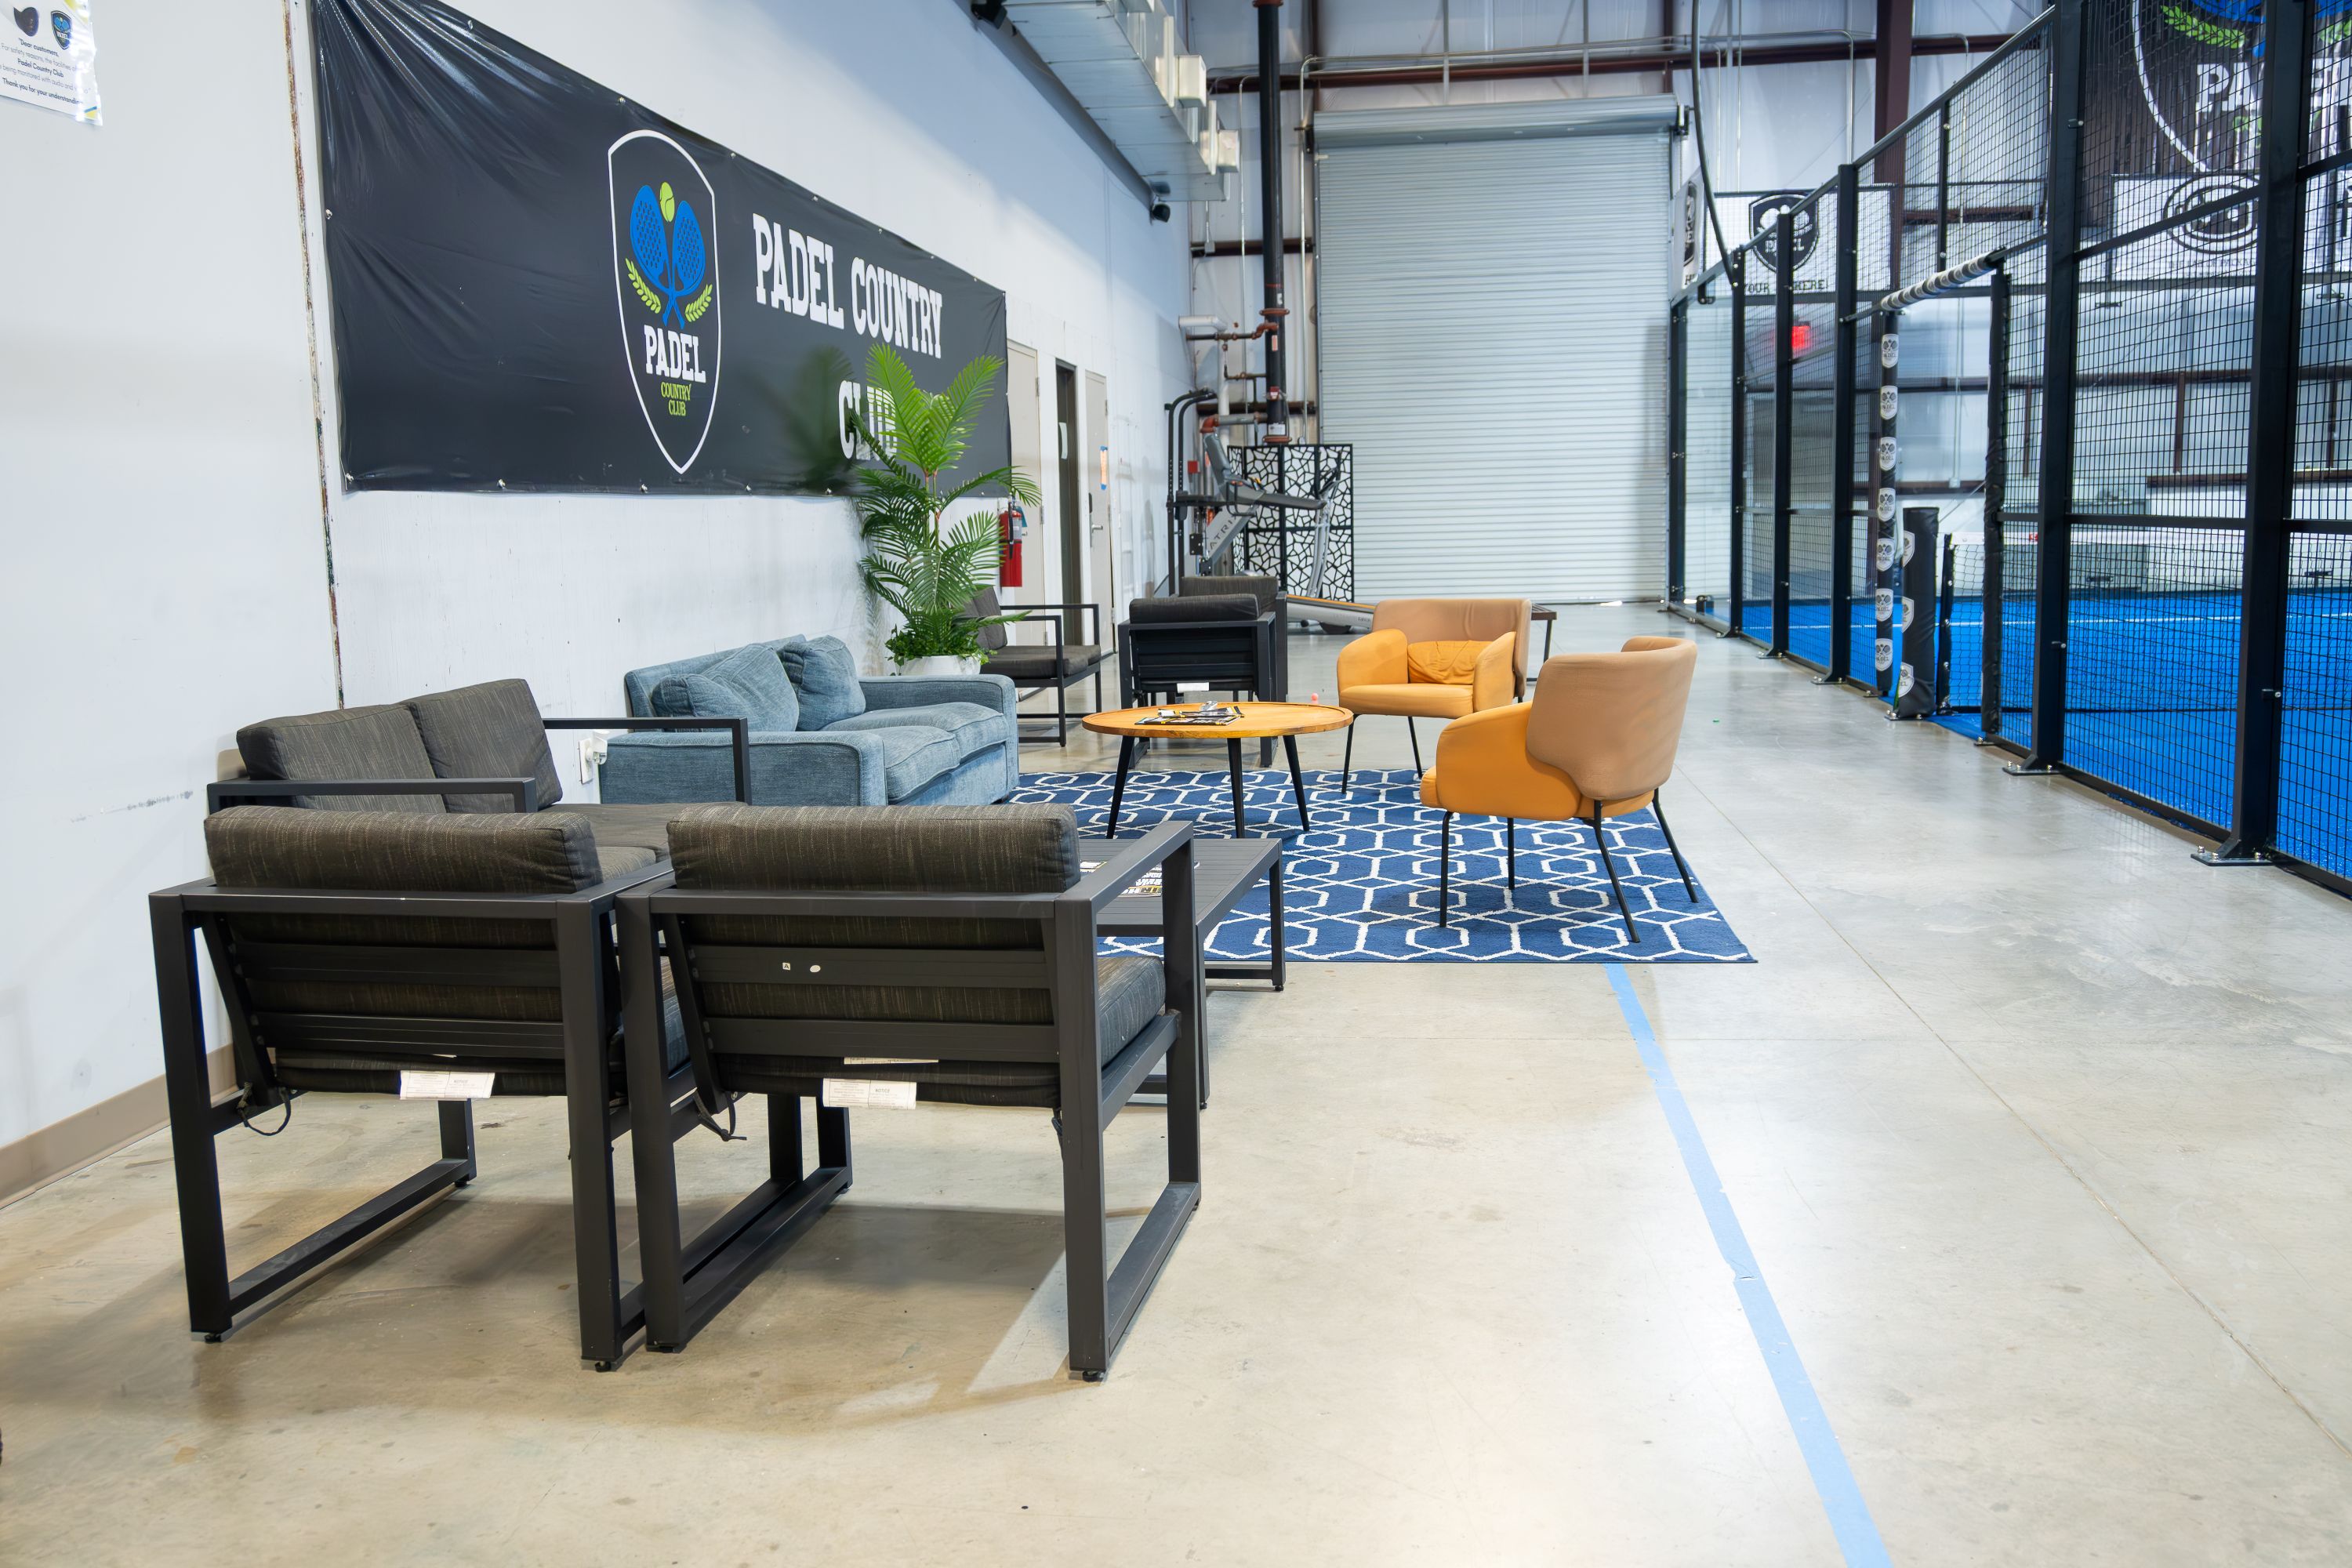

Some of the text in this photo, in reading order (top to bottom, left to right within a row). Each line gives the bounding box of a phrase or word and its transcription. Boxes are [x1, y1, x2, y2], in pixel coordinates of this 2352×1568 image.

[17, 58, 64, 78] Padel Country Club
[2, 77, 19, 88] Thank
[753, 212, 942, 359] PADEL COUNTRY
[644, 325, 706, 383] PADEL
[661, 382, 691, 401] COUNTRY
[669, 400, 686, 416] CLUB
